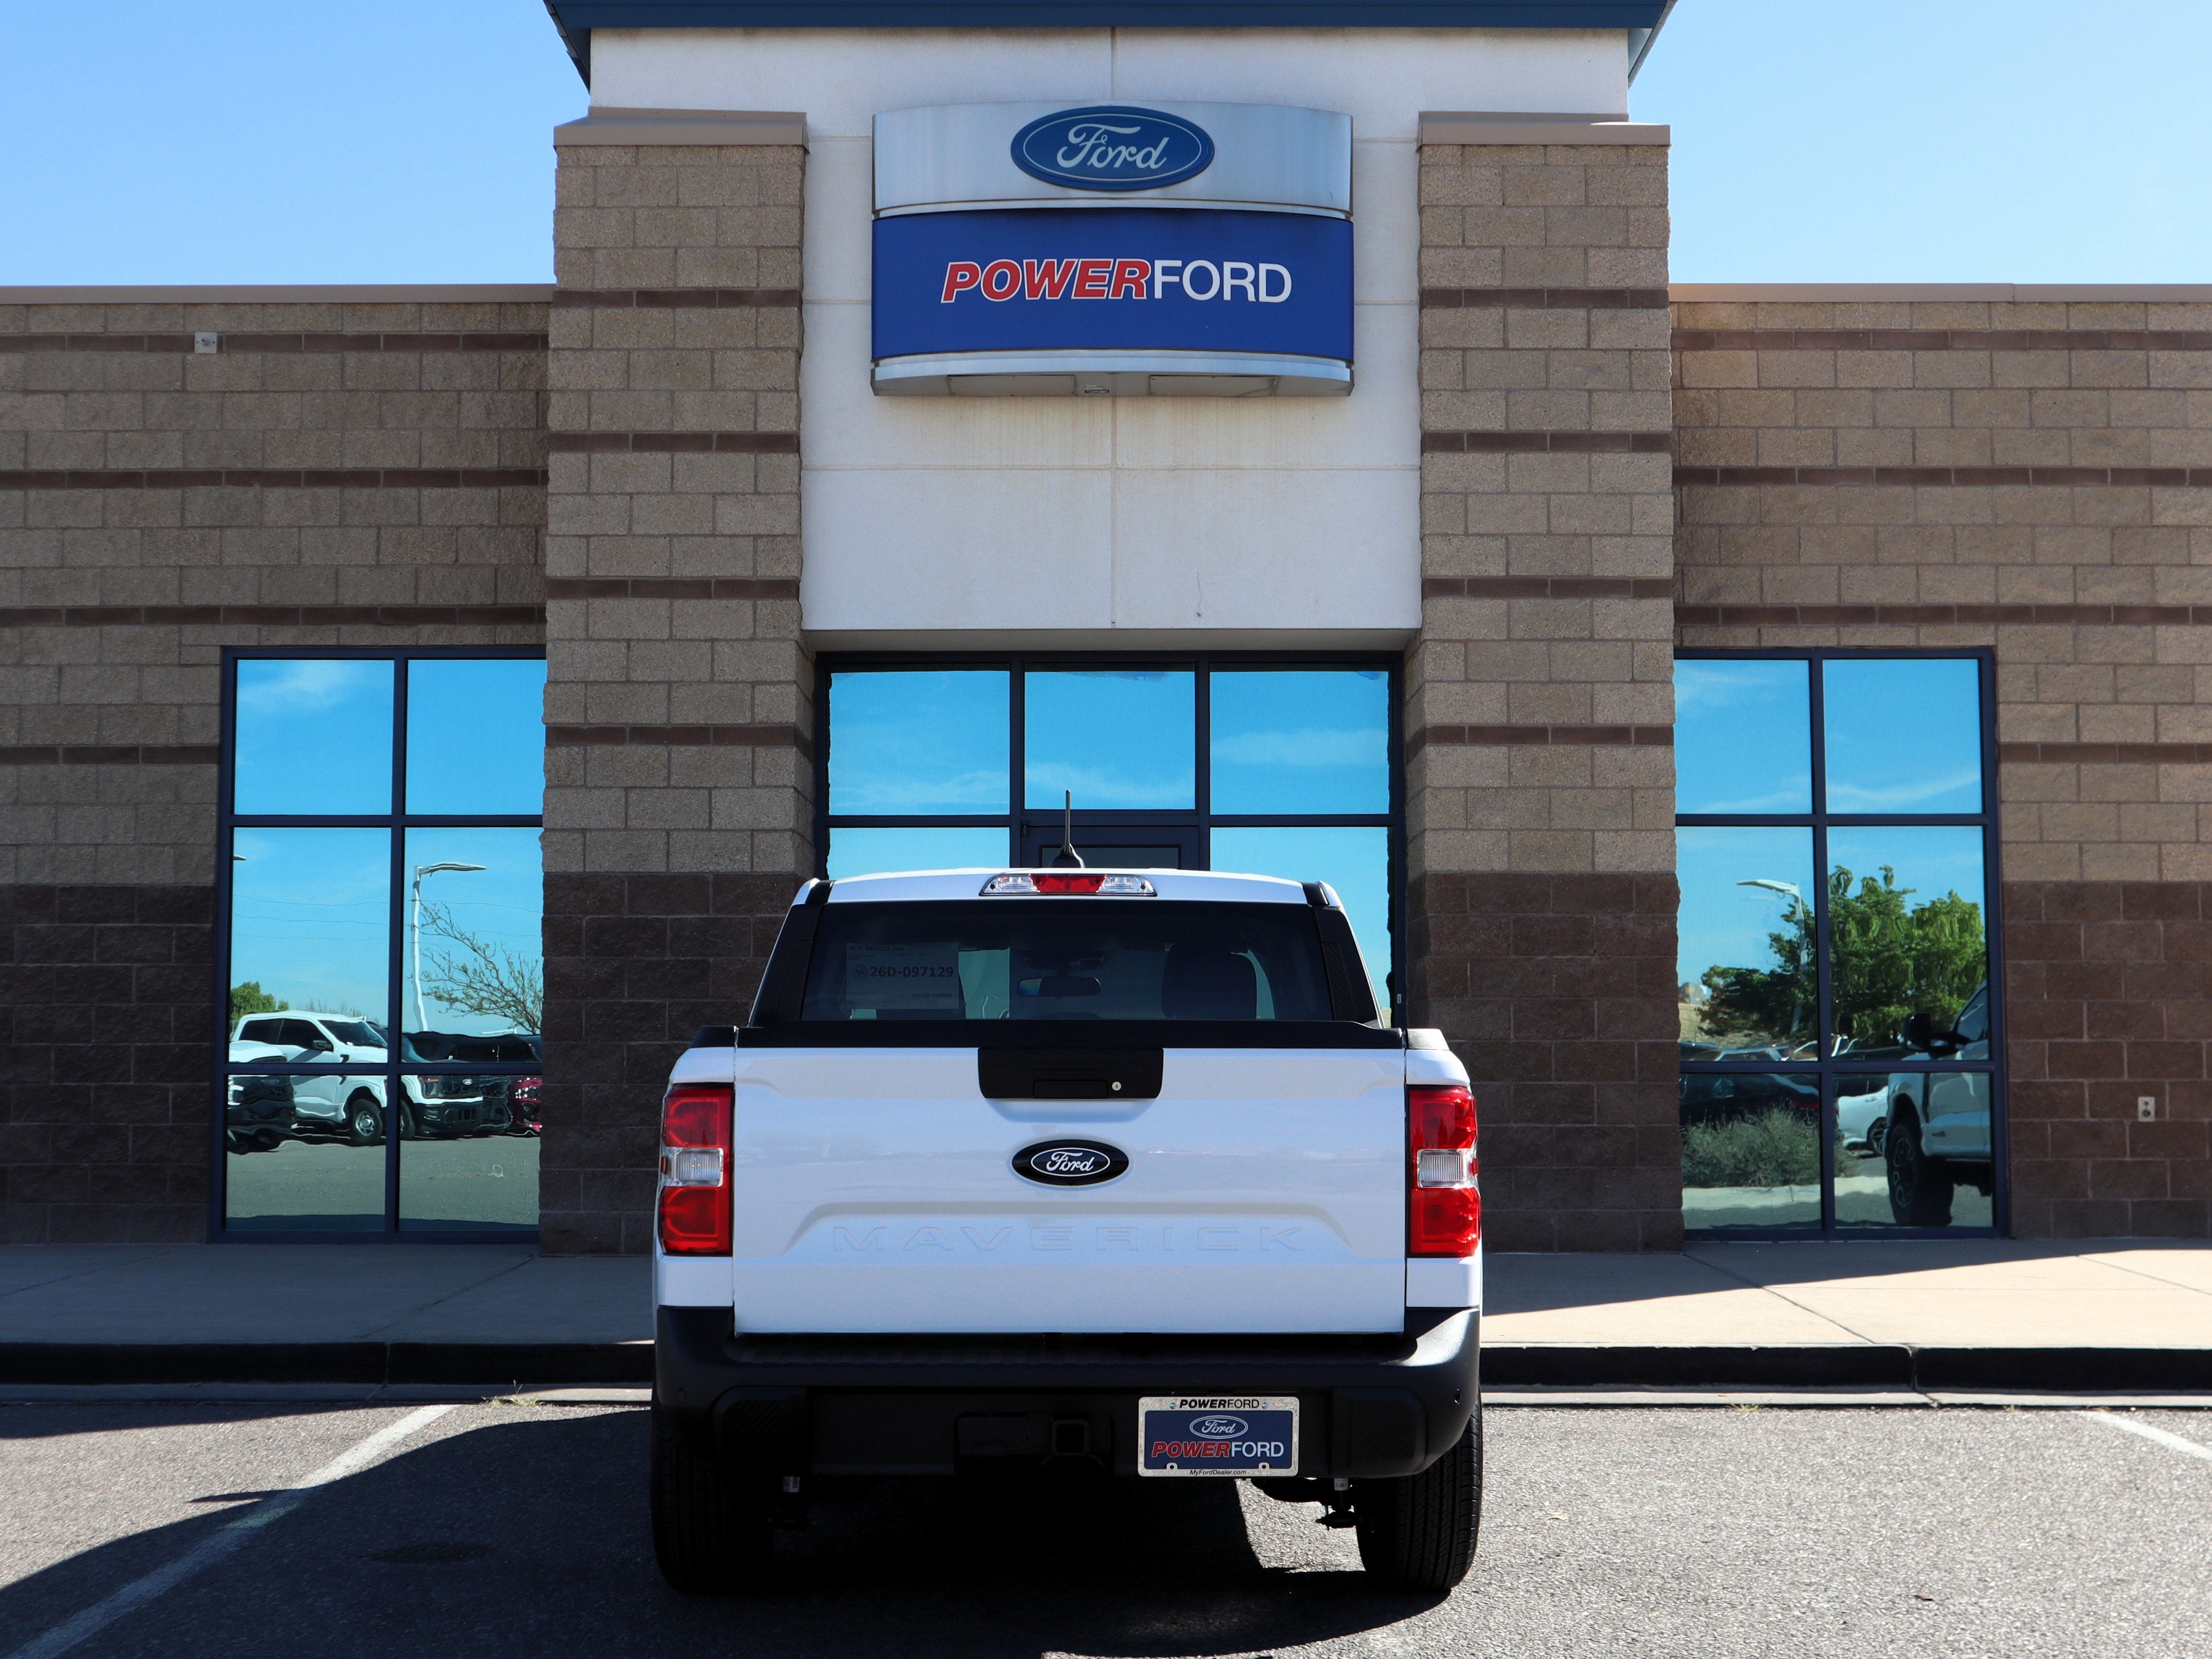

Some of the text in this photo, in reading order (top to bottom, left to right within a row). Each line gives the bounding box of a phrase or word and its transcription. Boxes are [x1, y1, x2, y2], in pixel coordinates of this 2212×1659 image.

[1056, 123, 1170, 170] Ford
[940, 258, 1292, 304] POWERFORD
[870, 966, 954, 977] 26D-097129
[1046, 1152, 1094, 1174] Ford
[832, 1226, 1306, 1252] MAVERICK
[1179, 1399, 1260, 1408] POWERFORD
[1201, 1420, 1236, 1434] Ford
[1151, 1442, 1284, 1457] POWERFORD
